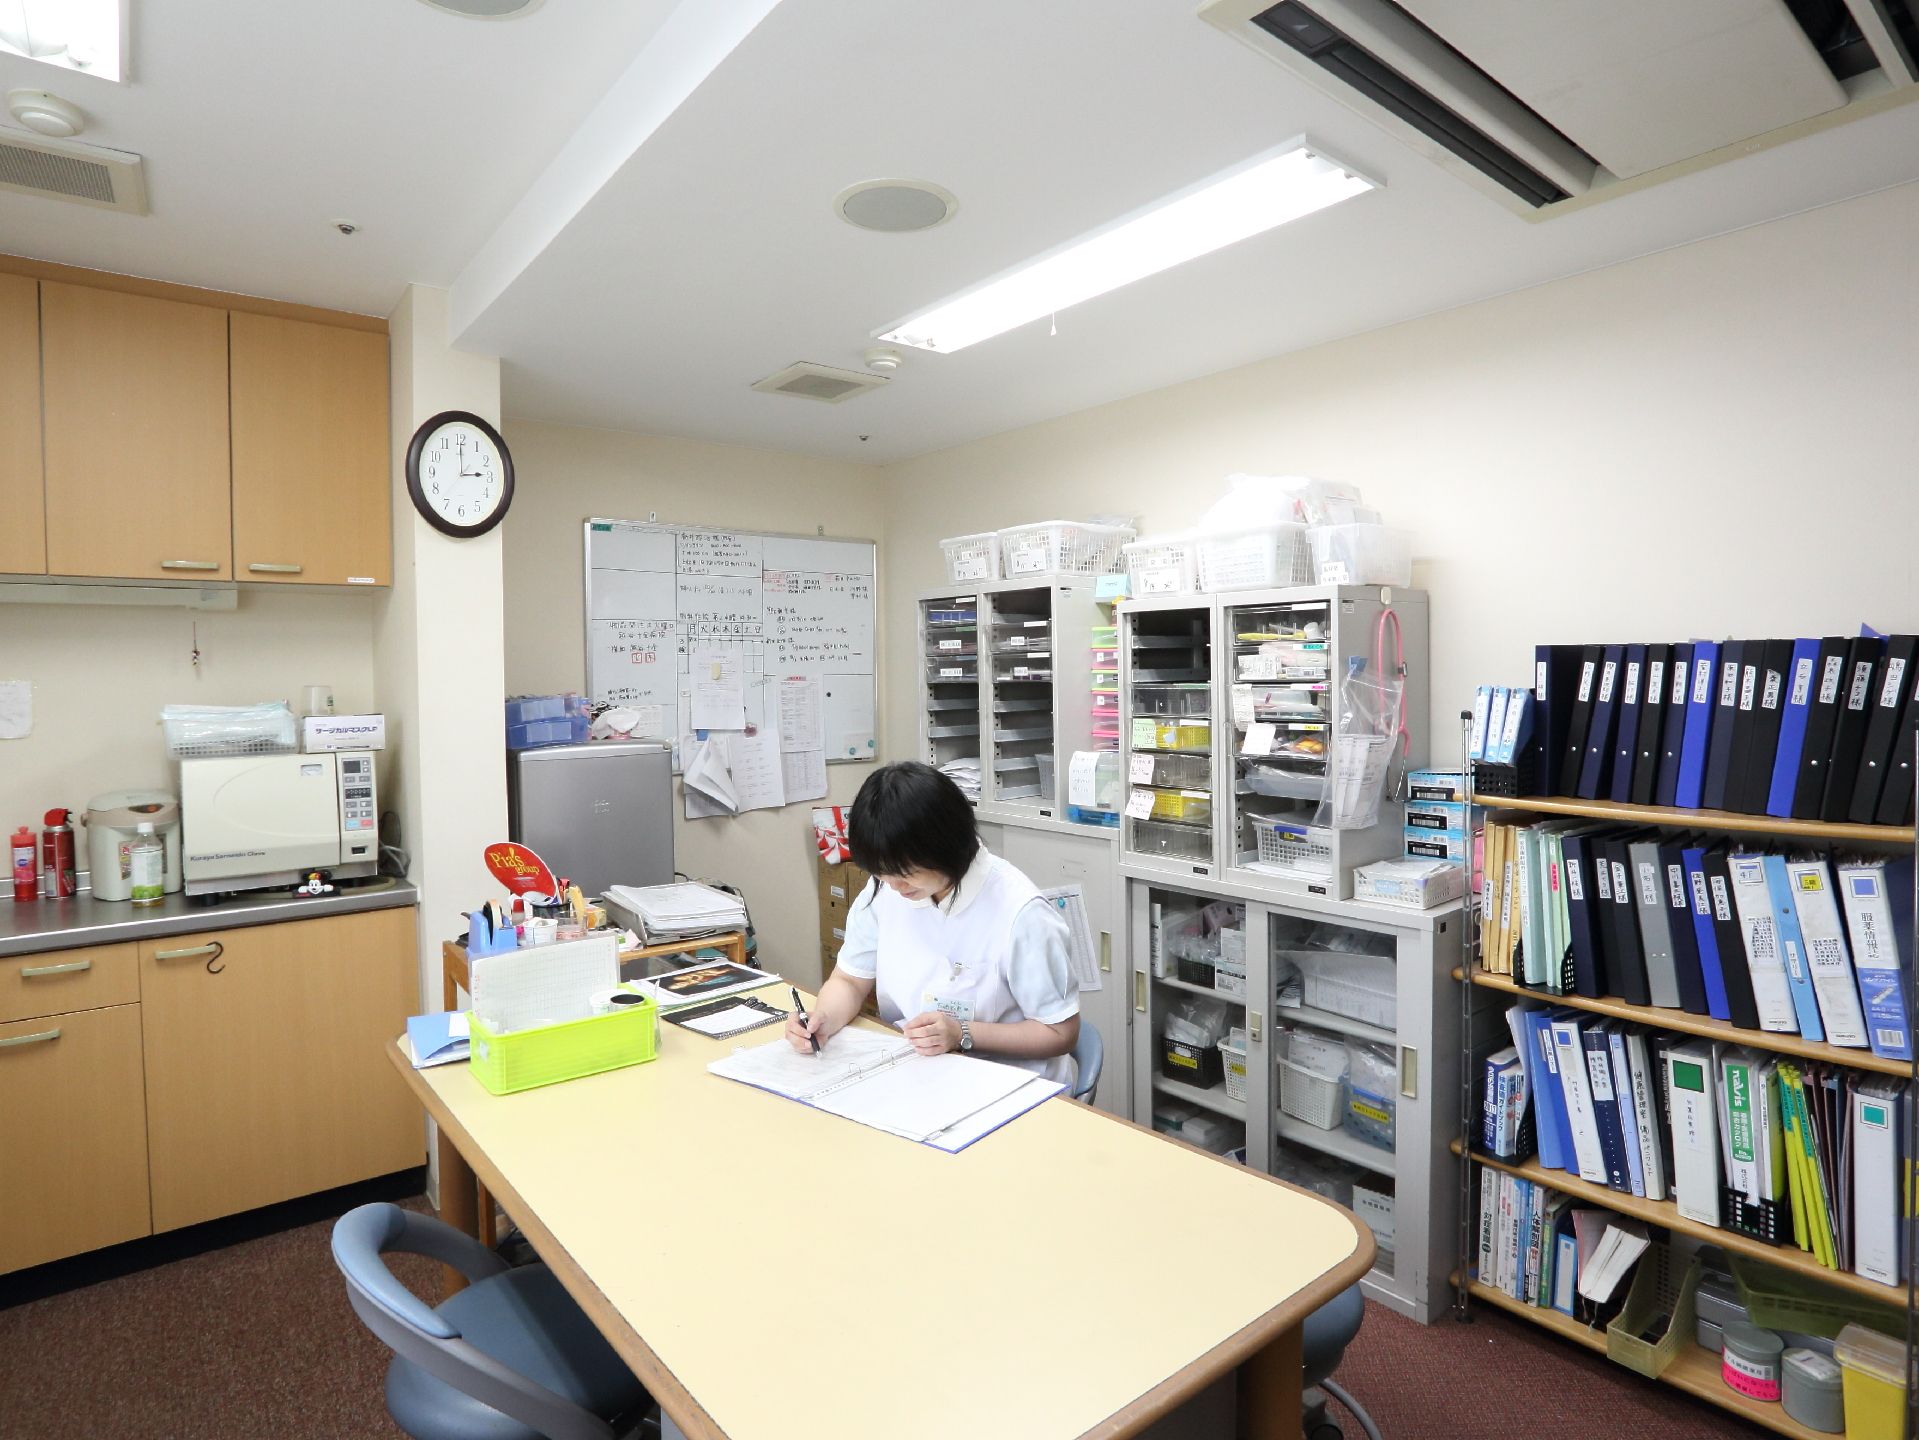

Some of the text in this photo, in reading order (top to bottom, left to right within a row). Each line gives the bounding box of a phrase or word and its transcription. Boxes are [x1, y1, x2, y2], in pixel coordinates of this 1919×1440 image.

[440, 438, 449, 449] 11
[456, 433, 466, 446] 12
[475, 441, 479, 452] 1
[431, 450, 441, 463] 10
[483, 455, 489, 467] 2
[428, 466, 436, 479] 9
[486, 471, 494, 483] 3
[432, 482, 439, 495] 8
[482, 487, 489, 499] 4
[443, 498, 450, 510] 7
[474, 500, 481, 513] 5
[458, 505, 465, 517] 6
